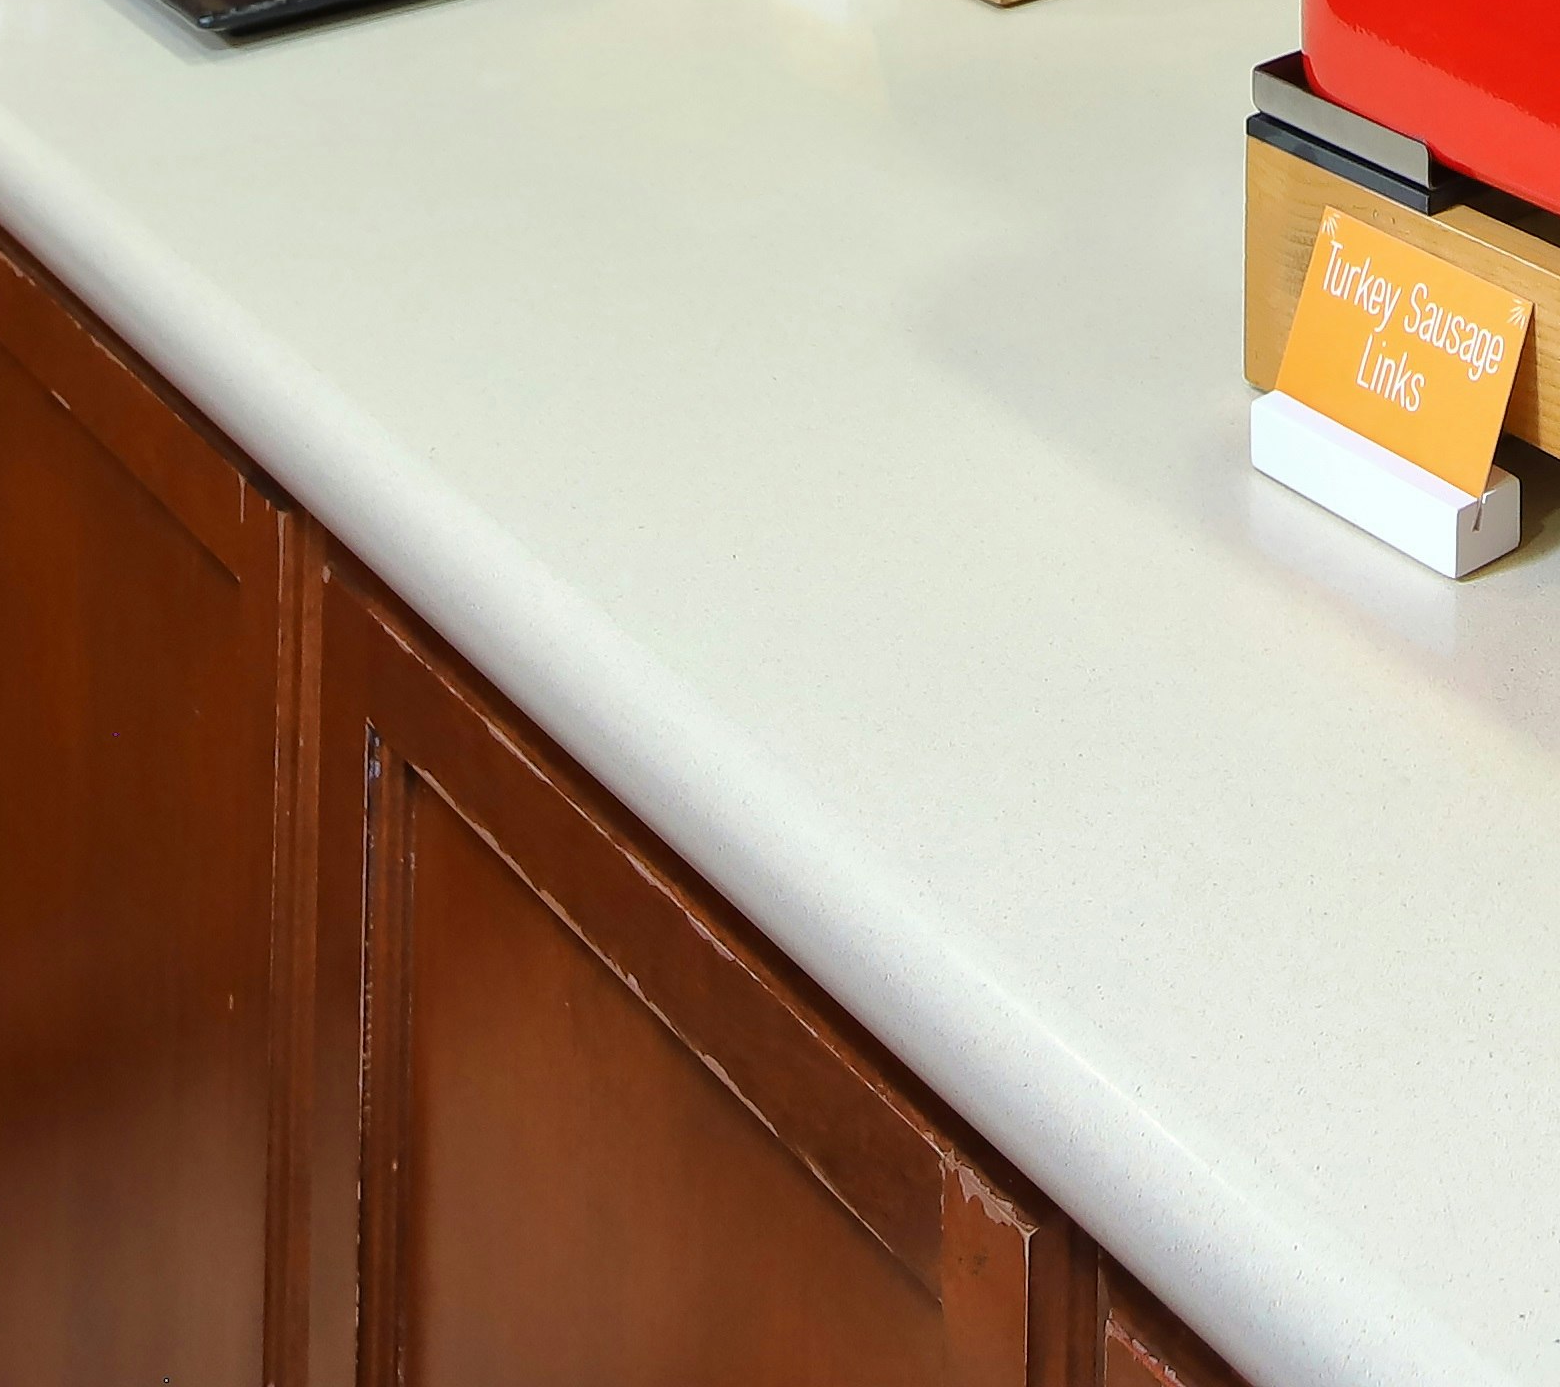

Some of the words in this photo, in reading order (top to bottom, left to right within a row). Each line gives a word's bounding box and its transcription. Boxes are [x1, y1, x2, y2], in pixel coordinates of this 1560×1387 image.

[1323, 239, 1402, 332] Turkey
[1403, 282, 1504, 381] Sausage
[1356, 332, 1425, 412] Links
